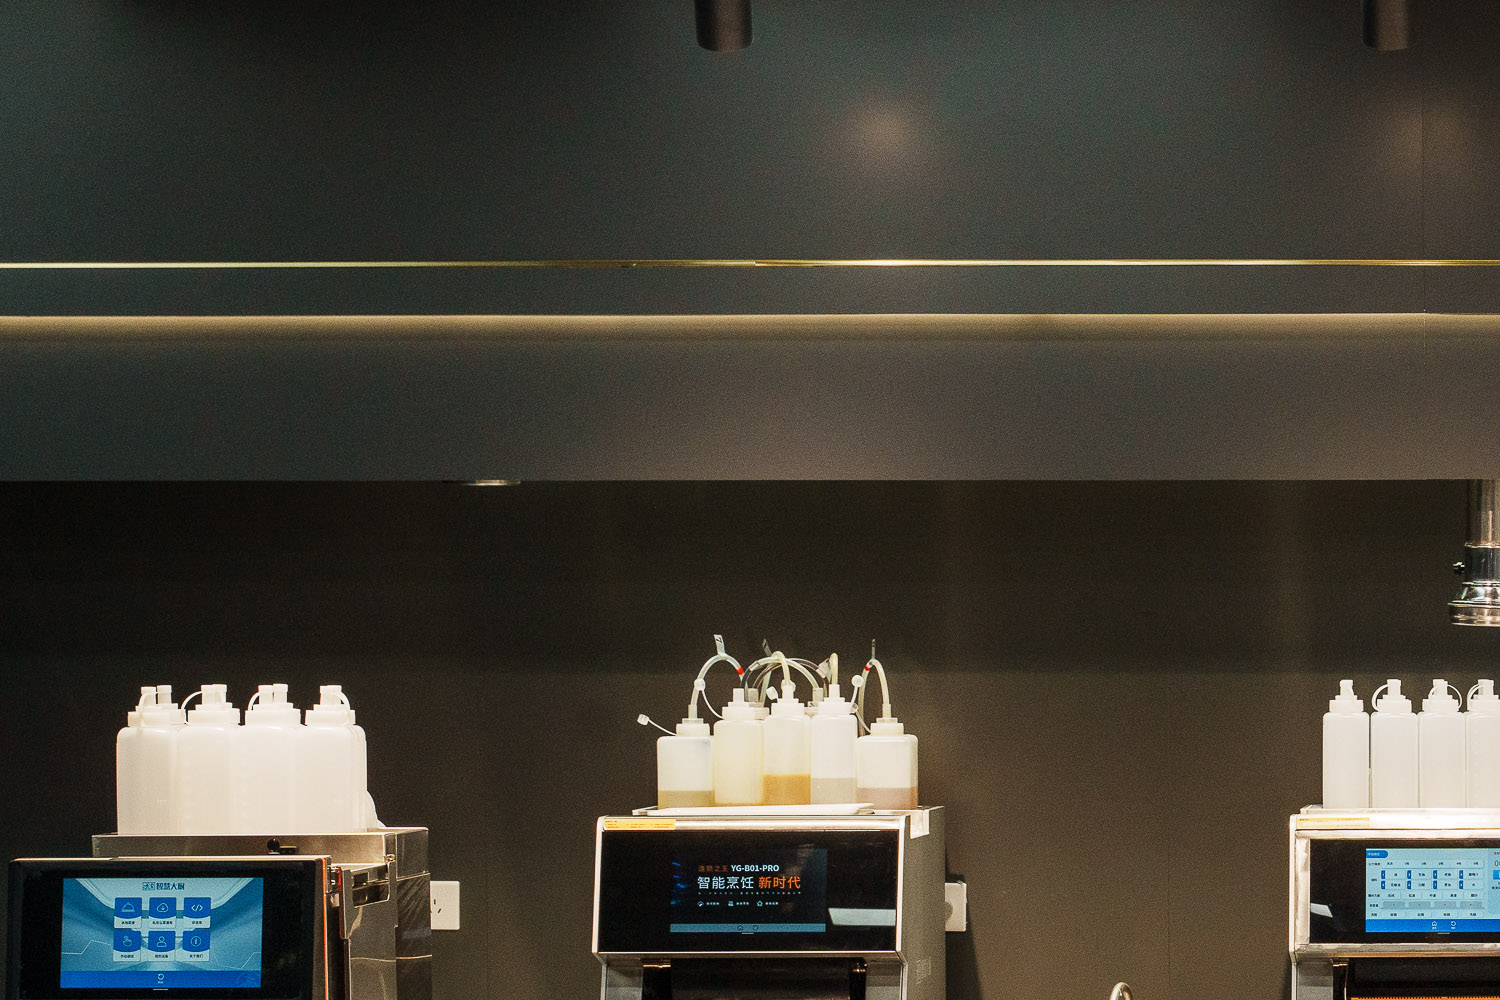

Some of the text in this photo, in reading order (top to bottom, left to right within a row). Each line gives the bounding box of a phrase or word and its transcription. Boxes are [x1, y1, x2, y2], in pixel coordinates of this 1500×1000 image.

[730, 864, 780, 872] YG-B01-PRO
[156, 882, 185, 890] 智慧大厨
[698, 876, 801, 889] 智能烹饪 新时代
